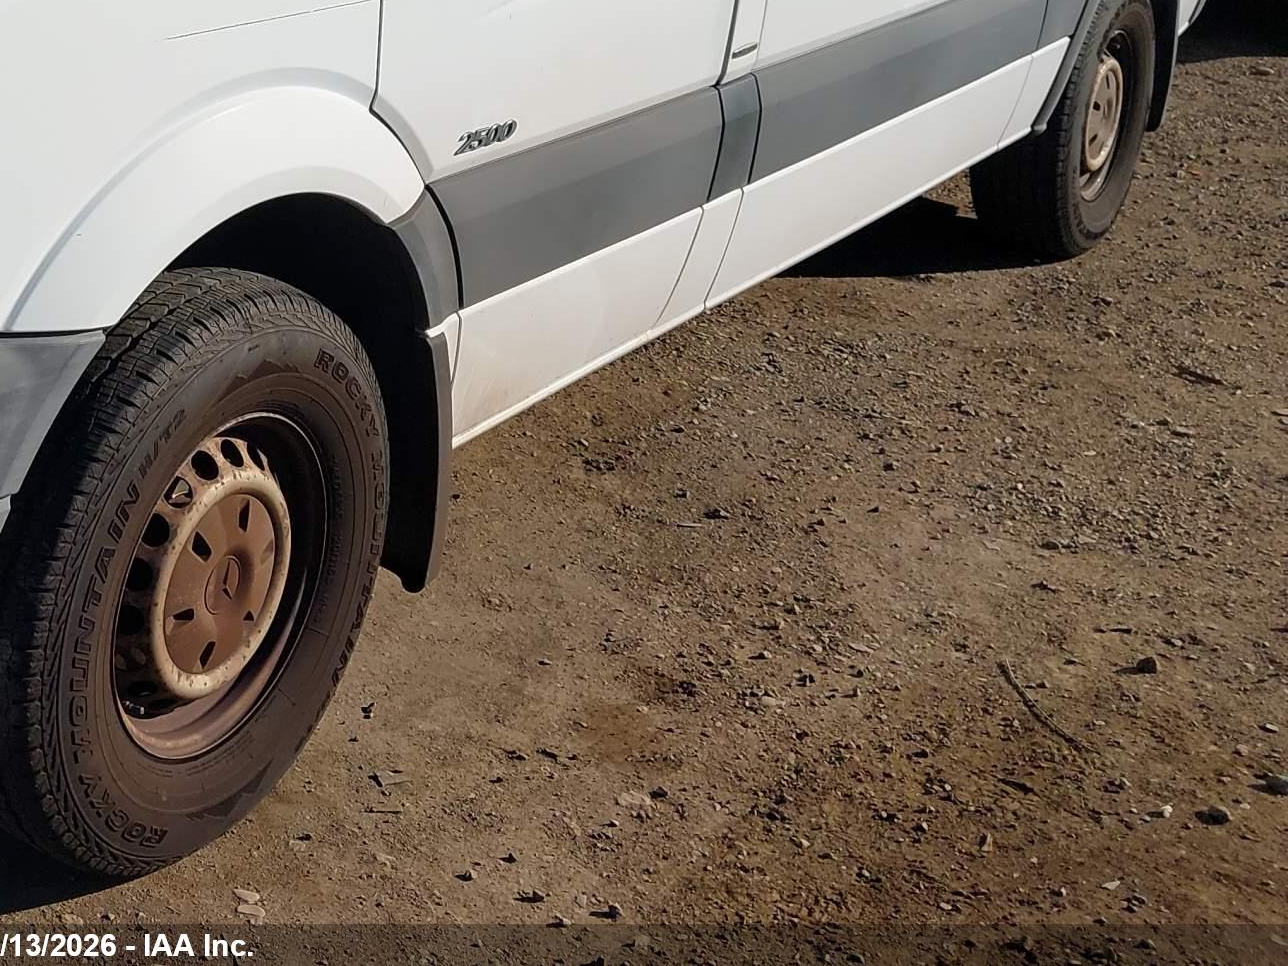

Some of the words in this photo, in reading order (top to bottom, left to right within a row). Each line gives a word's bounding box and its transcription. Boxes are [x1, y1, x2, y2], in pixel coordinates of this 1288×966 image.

[453, 118, 518, 157] 2500
[314, 346, 380, 437] ROCKY
[68, 480, 141, 765] MOUNTAIN
[78, 772, 168, 848] ROCKY
